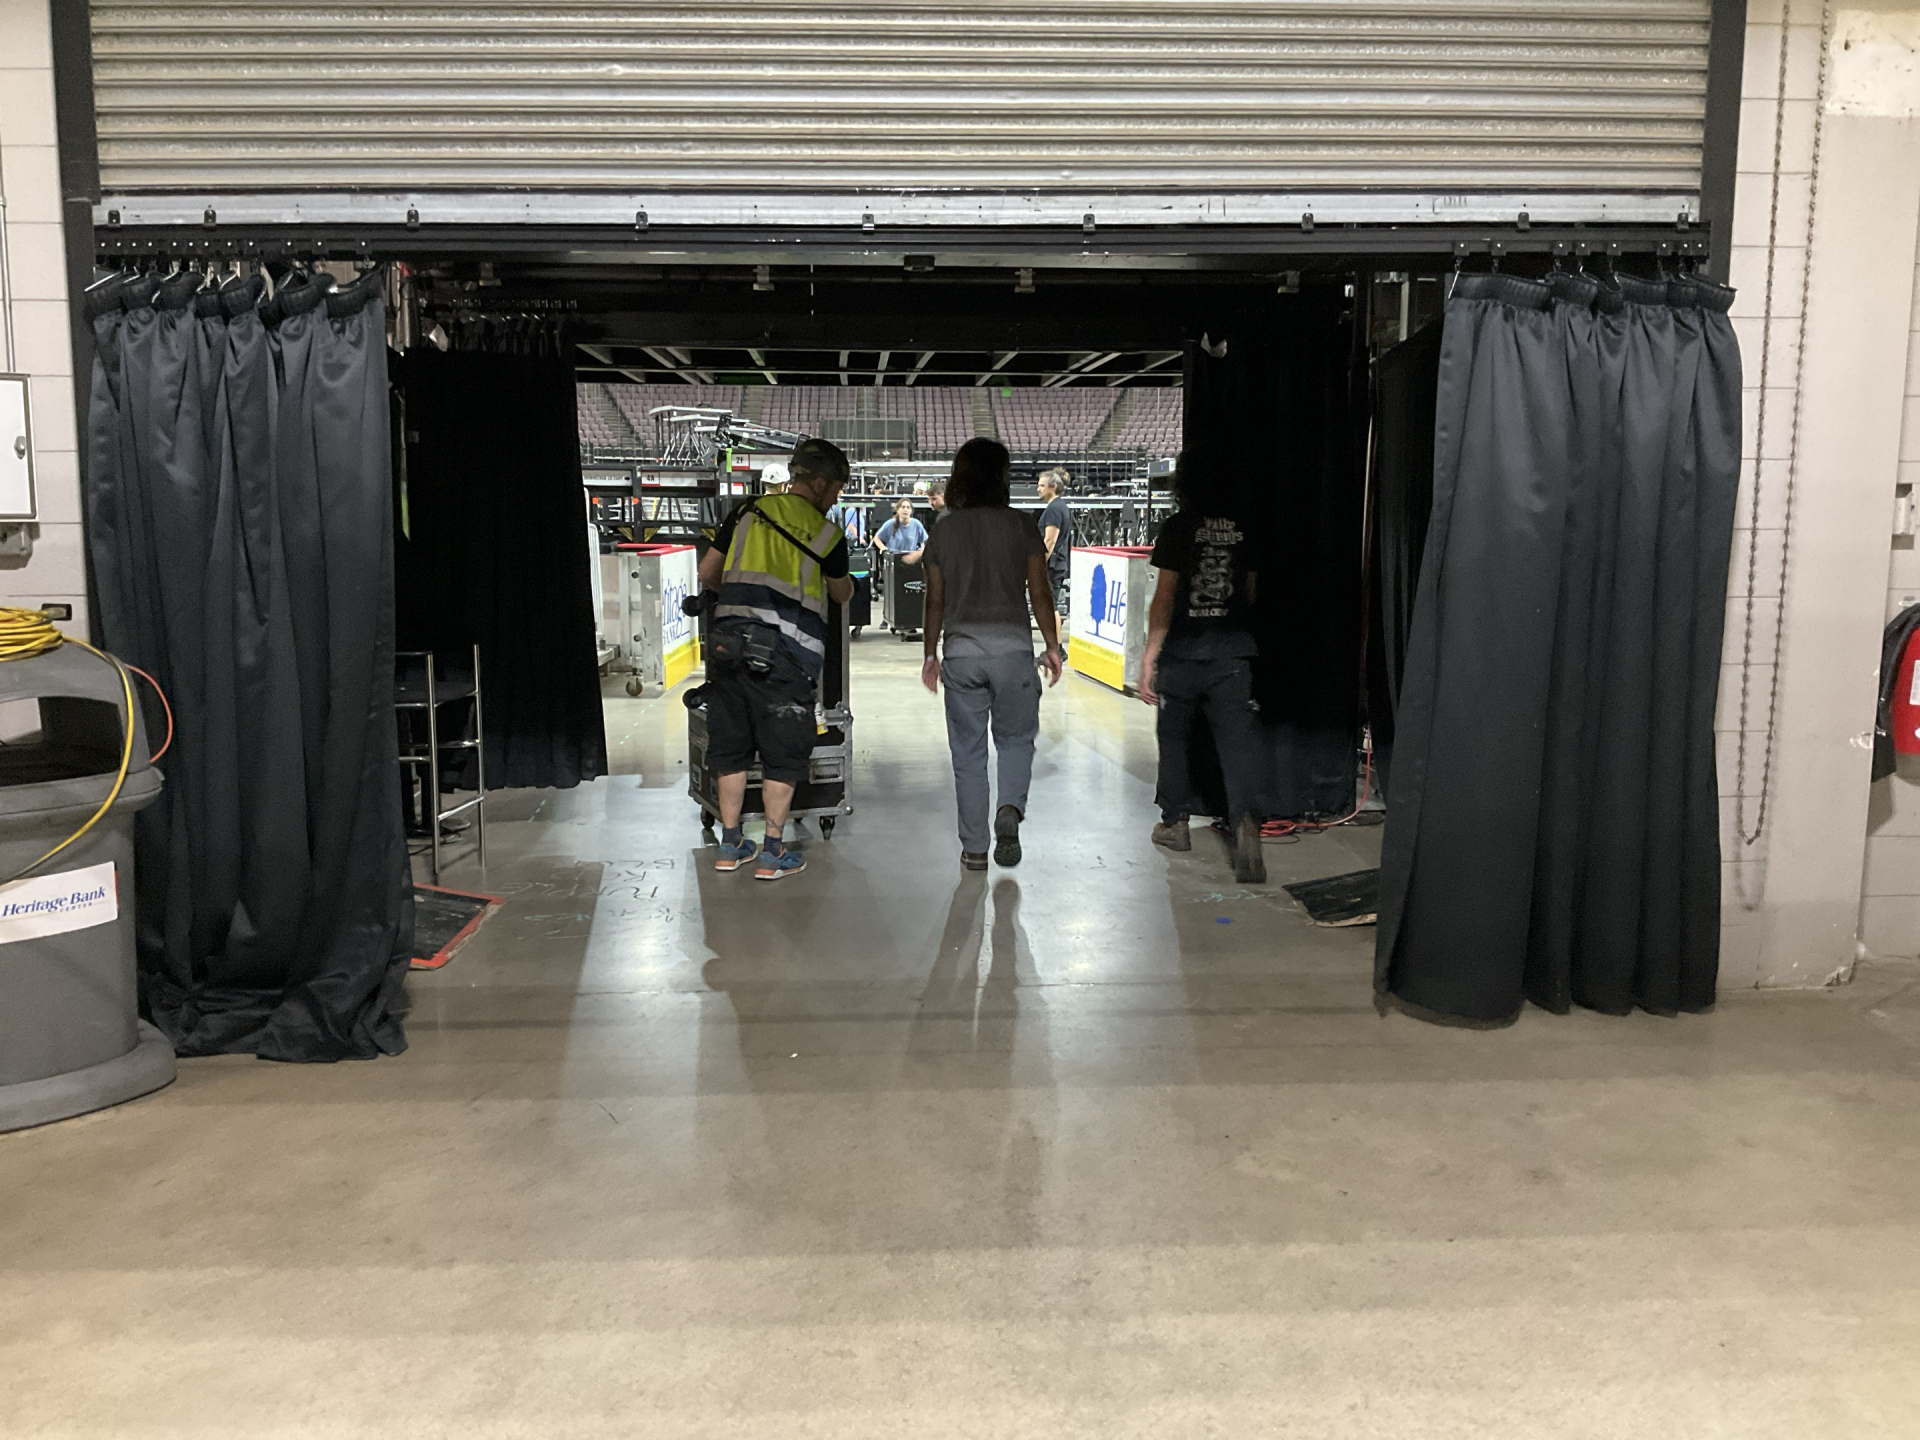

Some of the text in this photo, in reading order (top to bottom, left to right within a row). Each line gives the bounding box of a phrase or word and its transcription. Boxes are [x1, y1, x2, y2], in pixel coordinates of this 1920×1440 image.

[736, 456, 744, 464] 2F
[2, 886, 107, 917] Heritage Bank
